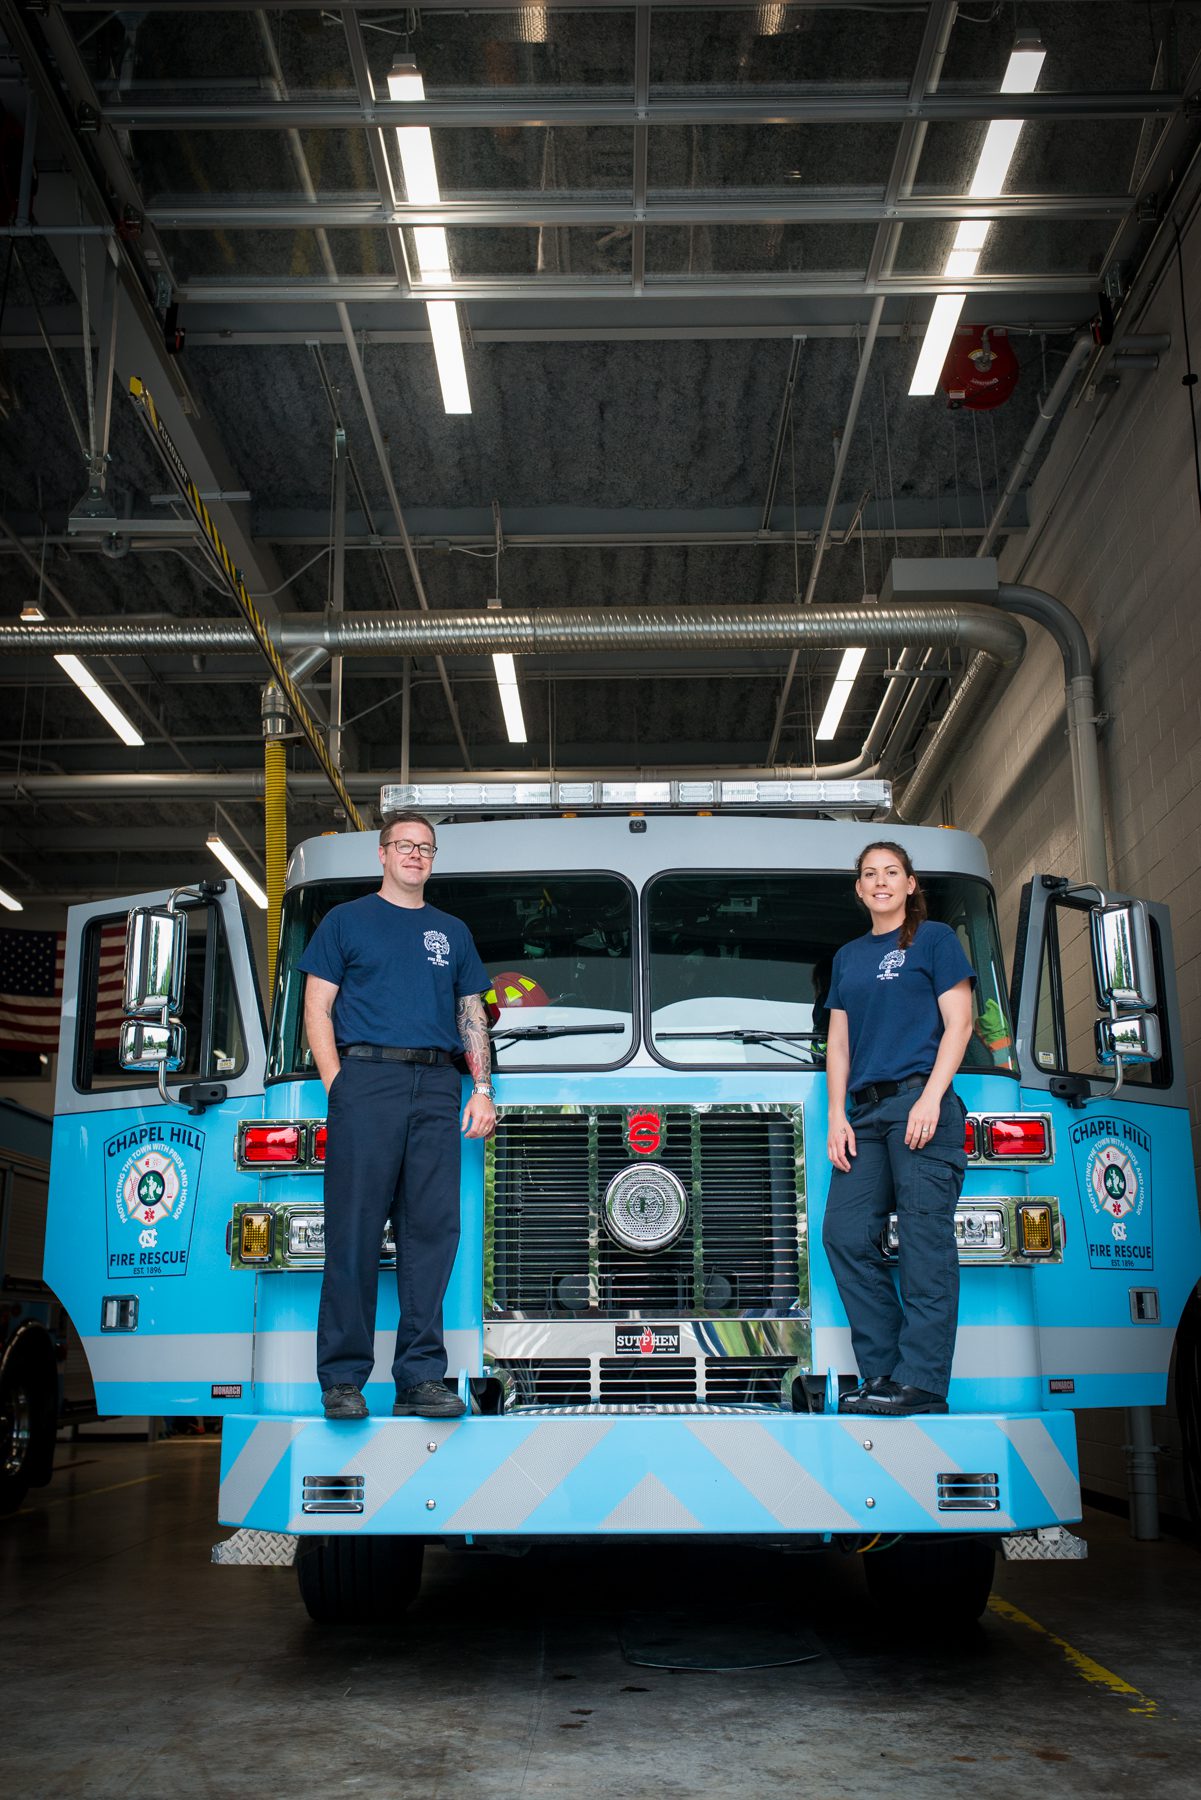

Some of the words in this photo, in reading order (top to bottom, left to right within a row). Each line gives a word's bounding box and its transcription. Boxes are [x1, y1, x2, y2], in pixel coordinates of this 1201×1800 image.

[107, 1126, 165, 1157] CHAPEL
[169, 1126, 201, 1151] HILL
[1072, 1120, 1120, 1144] CHAPEL
[1122, 1123, 1150, 1152] HILL
[1094, 1137, 1110, 1150] TOWN
[1110, 1137, 1125, 1149] WITH
[131, 1143, 152, 1160] TOWN
[152, 1143, 170, 1153] WITH
[1087, 1148, 1098, 1162] THE
[1124, 1145, 1139, 1166] PRIDE
[121, 1157, 134, 1173] THE
[168, 1148, 185, 1168] PRIDE
[180, 1168, 188, 1188] AND
[1135, 1167, 1144, 1185] AND
[1085, 1162, 1100, 1214] PROTECTING
[115, 1172, 128, 1224] PROTECTING
[172, 1188, 188, 1220] HONOR
[1136, 1185, 1145, 1216] HONOR
[109, 1253, 135, 1267] FIRE
[139, 1250, 187, 1265] RESCUE
[1089, 1244, 1112, 1257] FIRE
[1114, 1245, 1152, 1259] RESCUE
[133, 1267, 145, 1275] EST.
[146, 1266, 162, 1274] 1896
[616, 1335, 679, 1346] SUTPHEN
[212, 1385, 241, 1396] MONARCH
